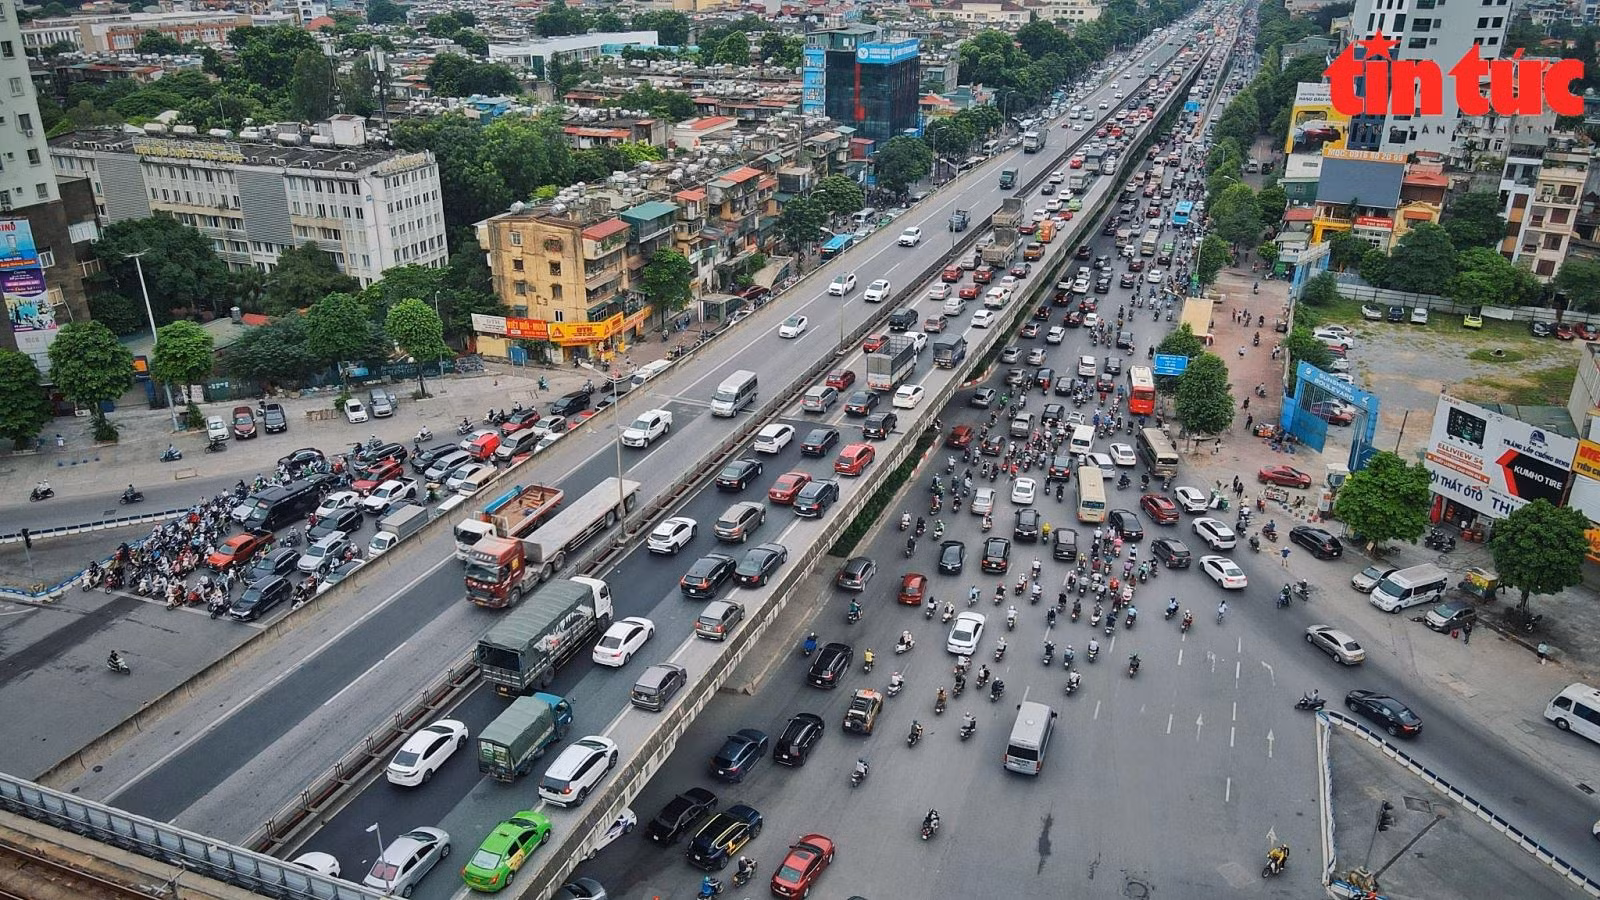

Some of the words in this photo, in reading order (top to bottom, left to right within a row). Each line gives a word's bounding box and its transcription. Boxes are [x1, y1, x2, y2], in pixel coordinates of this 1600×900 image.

[536, 294, 548, 306] C3
[1314, 377, 1354, 402] BOULEVARD
[1319, 373, 1352, 393] SUNSHINE
[1437, 442, 1474, 461] ELLIVIEW
[1441, 474, 1463, 494] THẤT
[1513, 465, 1544, 483] KUMHO
[1543, 474, 1563, 490] TIRE
